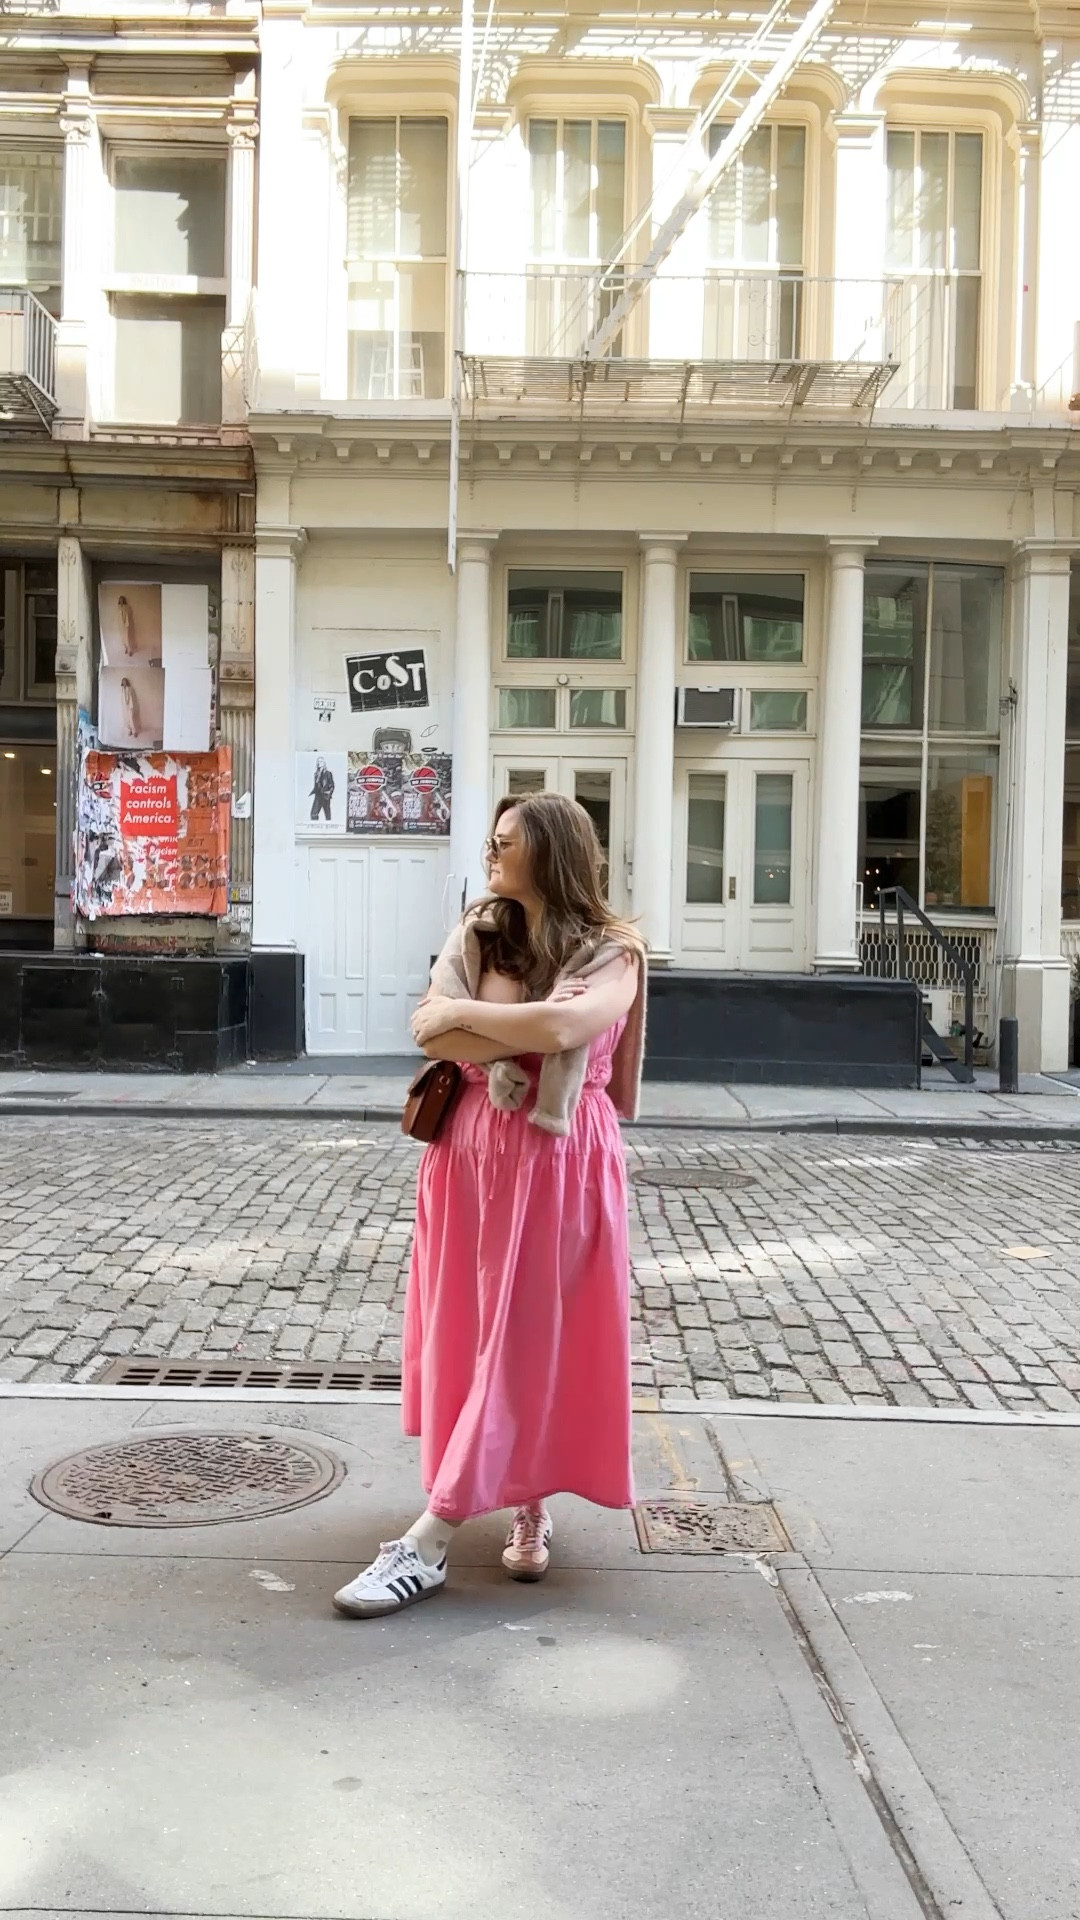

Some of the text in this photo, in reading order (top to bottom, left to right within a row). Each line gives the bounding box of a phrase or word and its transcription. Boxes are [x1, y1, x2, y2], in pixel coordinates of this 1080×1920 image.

[129, 782, 167, 794] racism
[126, 796, 172, 809] controls
[122, 812, 175, 824] America.
